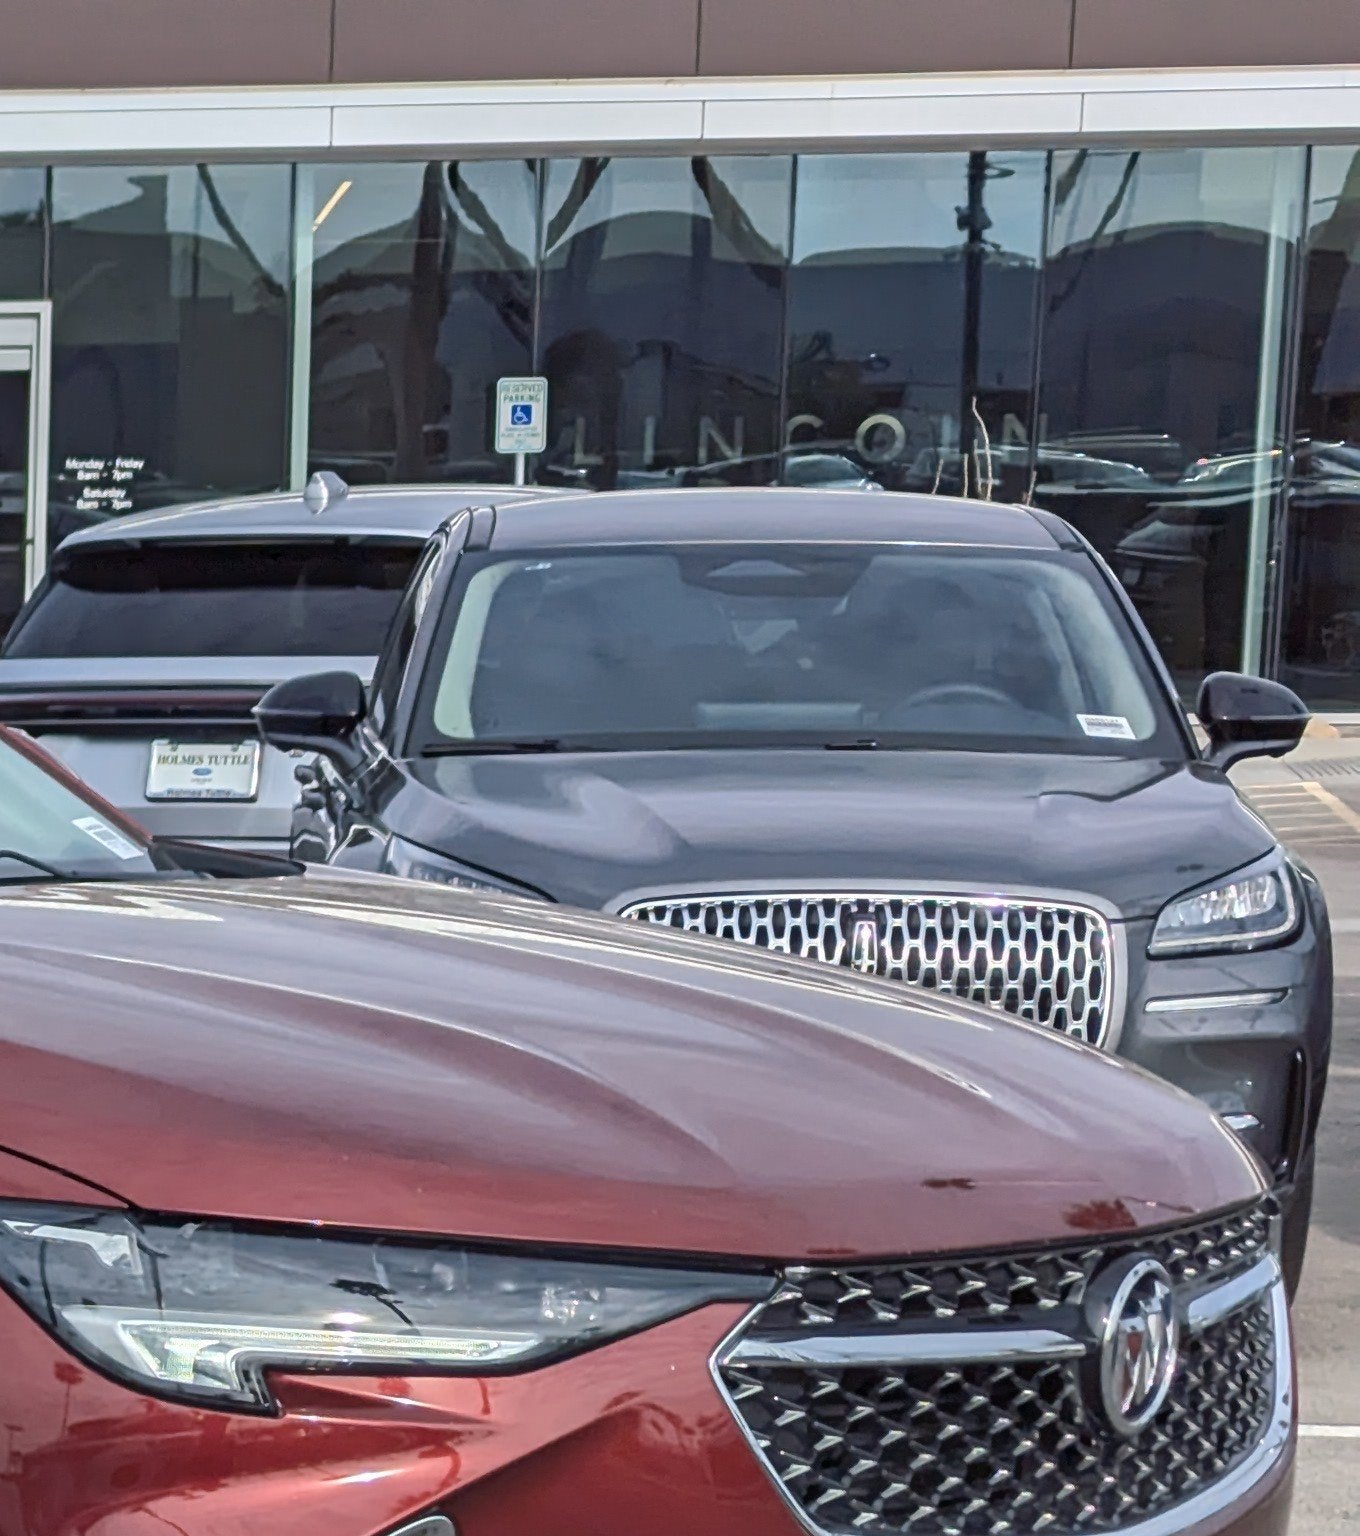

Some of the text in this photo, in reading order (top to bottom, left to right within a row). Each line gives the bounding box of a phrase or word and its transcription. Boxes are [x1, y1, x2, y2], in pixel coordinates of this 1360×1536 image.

[65, 457, 105, 470] Monday
[116, 457, 145, 470] Friday
[157, 754, 252, 766] HOLMES TUTTLE
